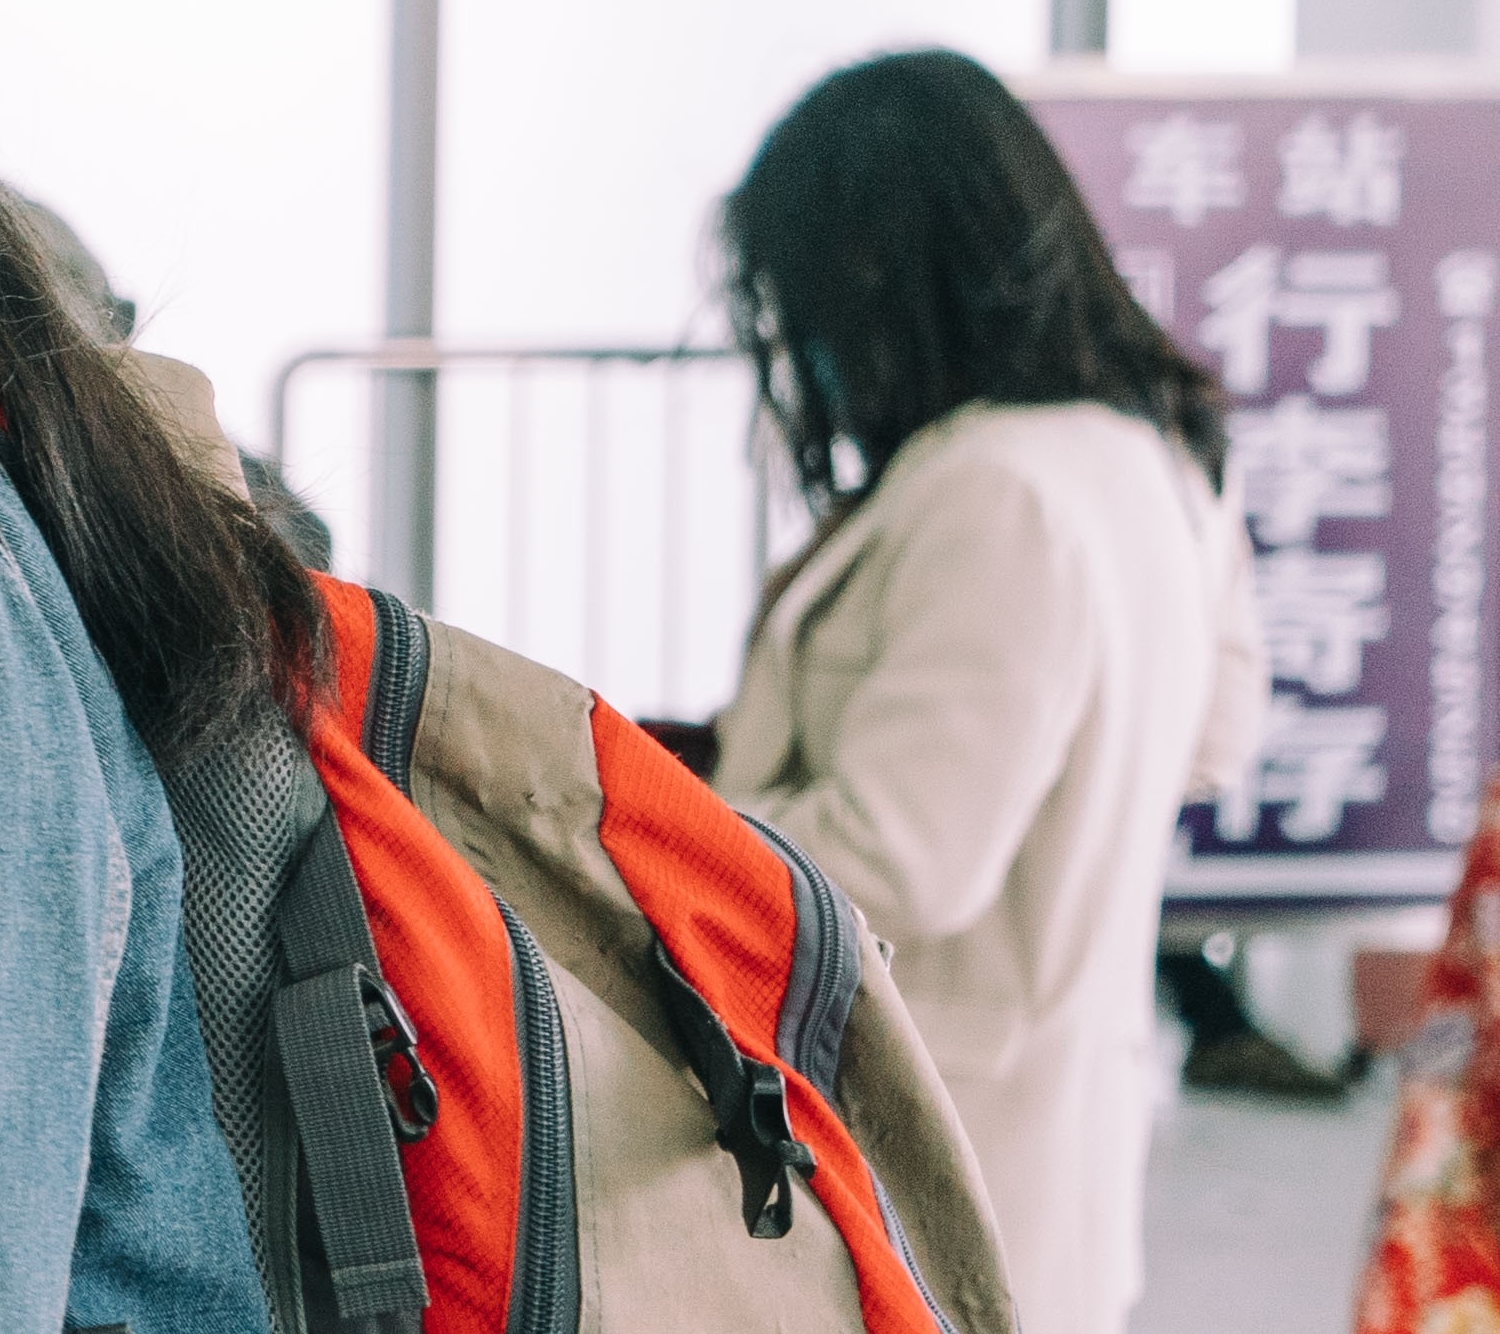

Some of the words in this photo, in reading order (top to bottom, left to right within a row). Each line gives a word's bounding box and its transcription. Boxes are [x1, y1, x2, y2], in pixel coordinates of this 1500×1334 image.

[1123, 114, 1403, 227] 车站
[1201, 246, 1401, 844] 行李寄存
